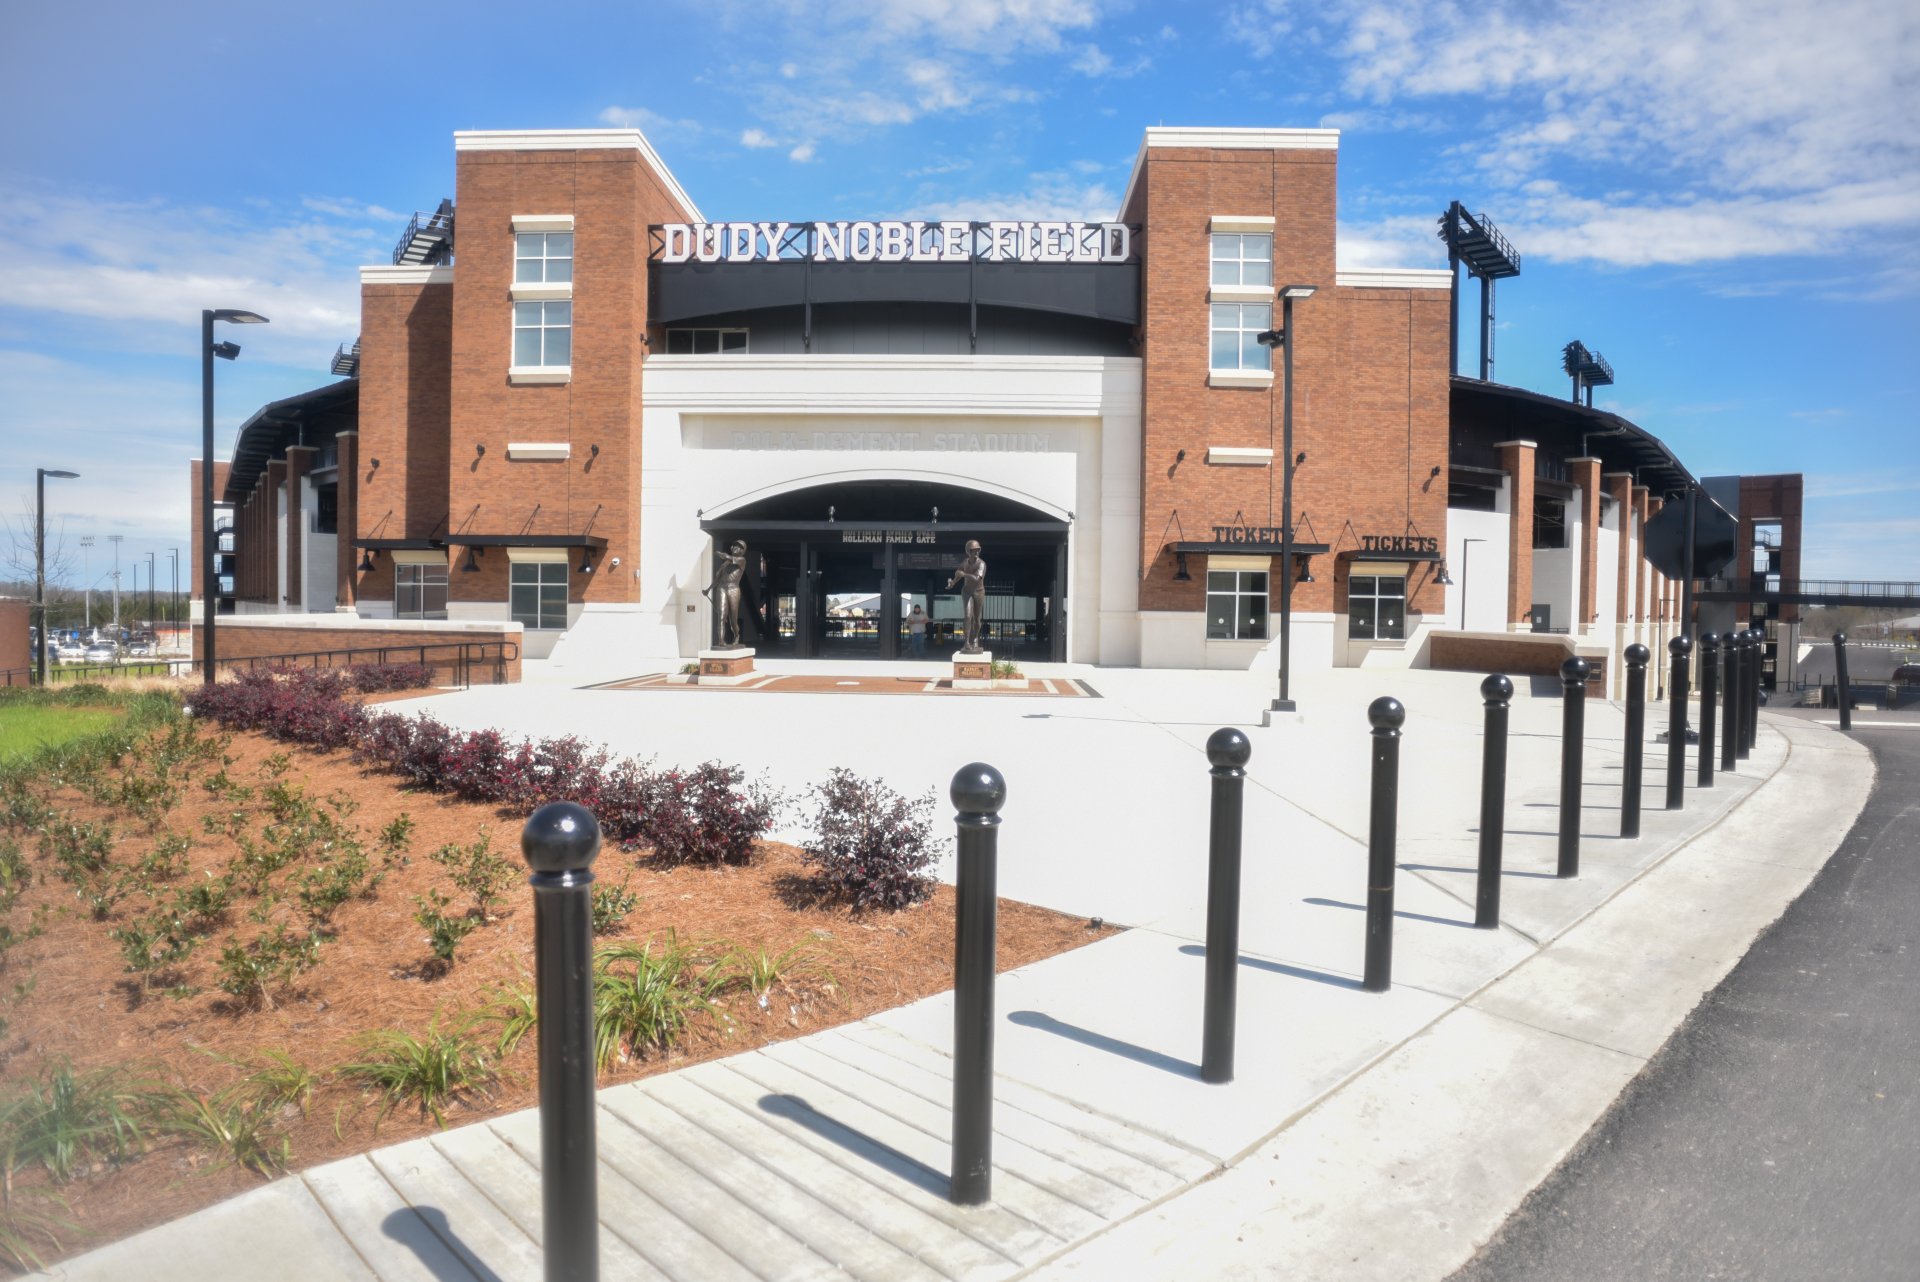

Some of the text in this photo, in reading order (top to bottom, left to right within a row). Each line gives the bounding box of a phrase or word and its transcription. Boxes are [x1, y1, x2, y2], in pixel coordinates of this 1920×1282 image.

[662, 221, 1130, 263] DUDY NOBLE FIELD
[731, 431, 1052, 451] POLK-DEMENT STADIUM
[843, 535, 882, 543] HOLLIMAN
[1212, 527, 1295, 544] TICKET
[1362, 535, 1438, 551] TICKETS
